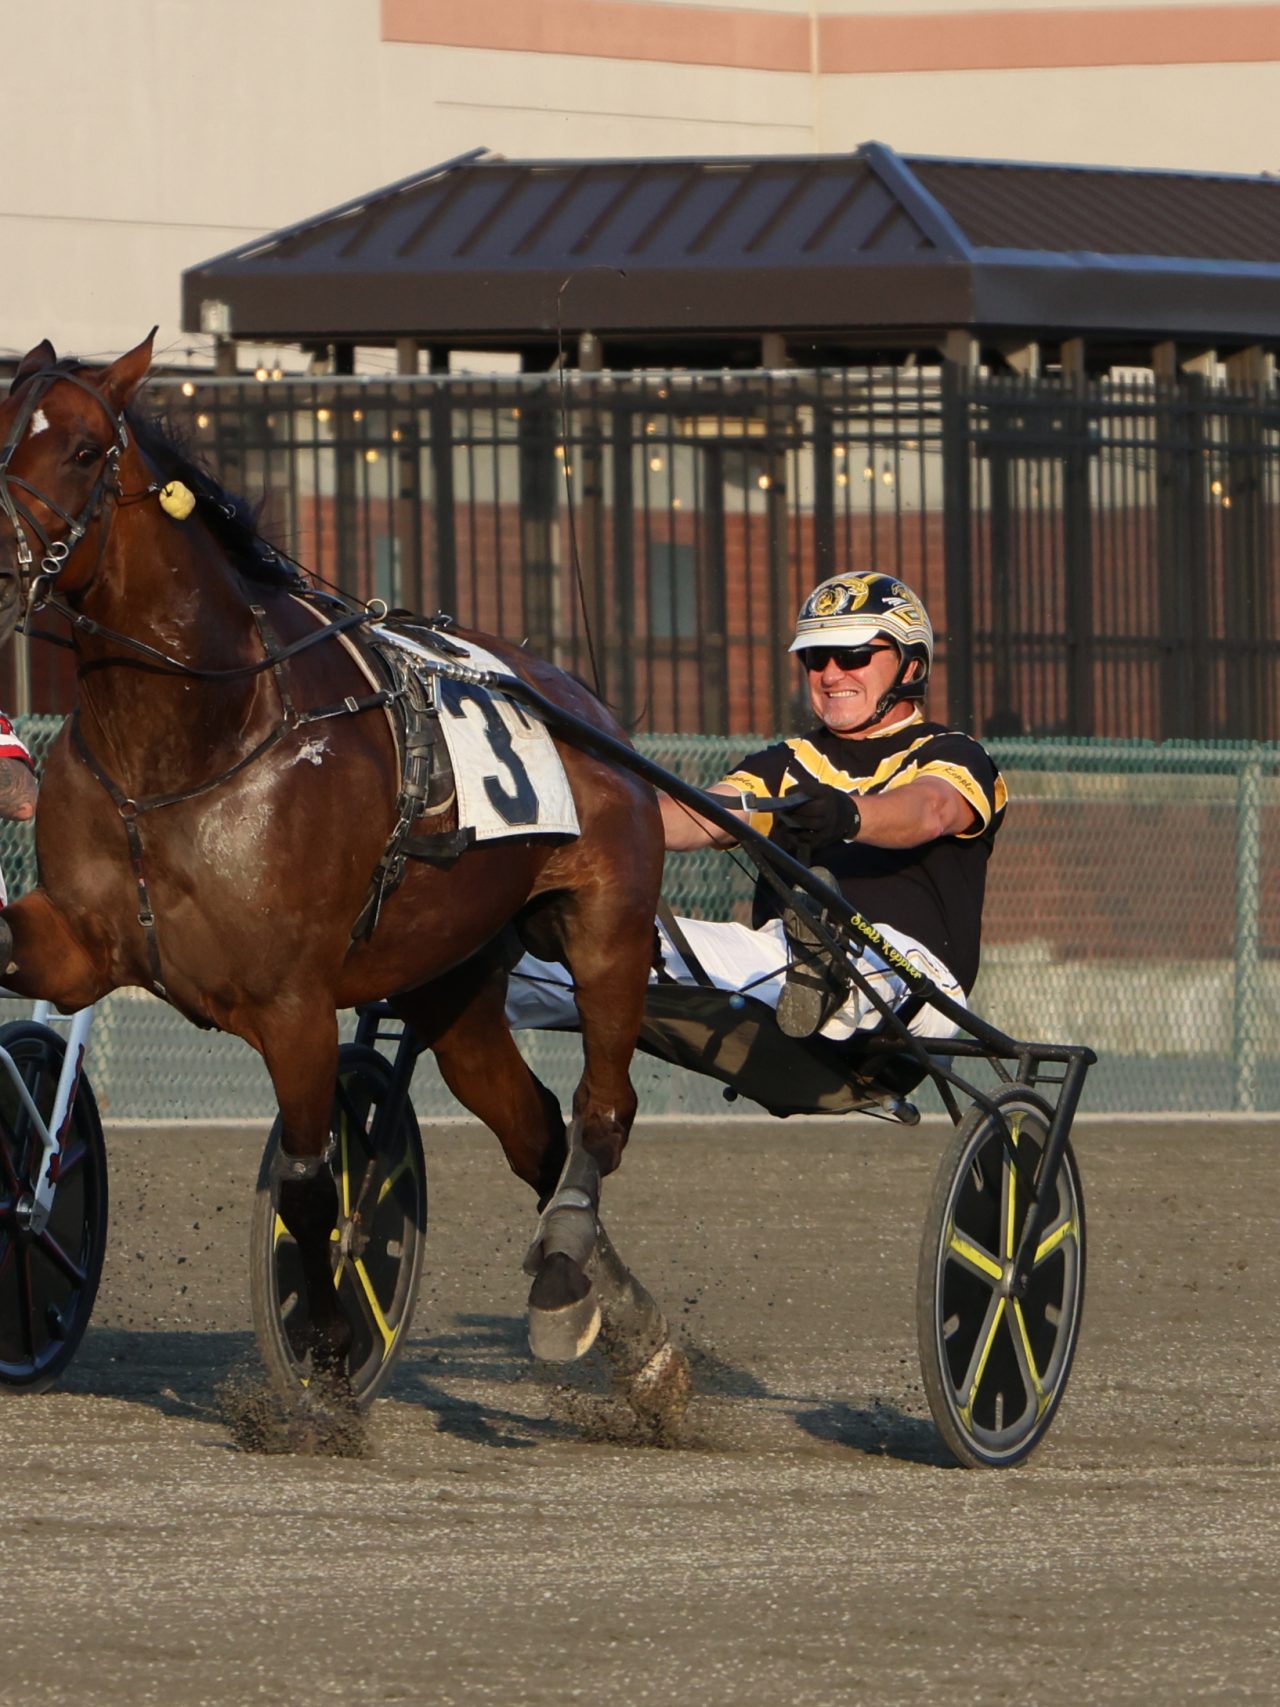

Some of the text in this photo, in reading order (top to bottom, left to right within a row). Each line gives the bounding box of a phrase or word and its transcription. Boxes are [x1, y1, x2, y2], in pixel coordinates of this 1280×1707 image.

[438, 674, 540, 826] 3
[850, 912, 922, 979] Scott Keppler
